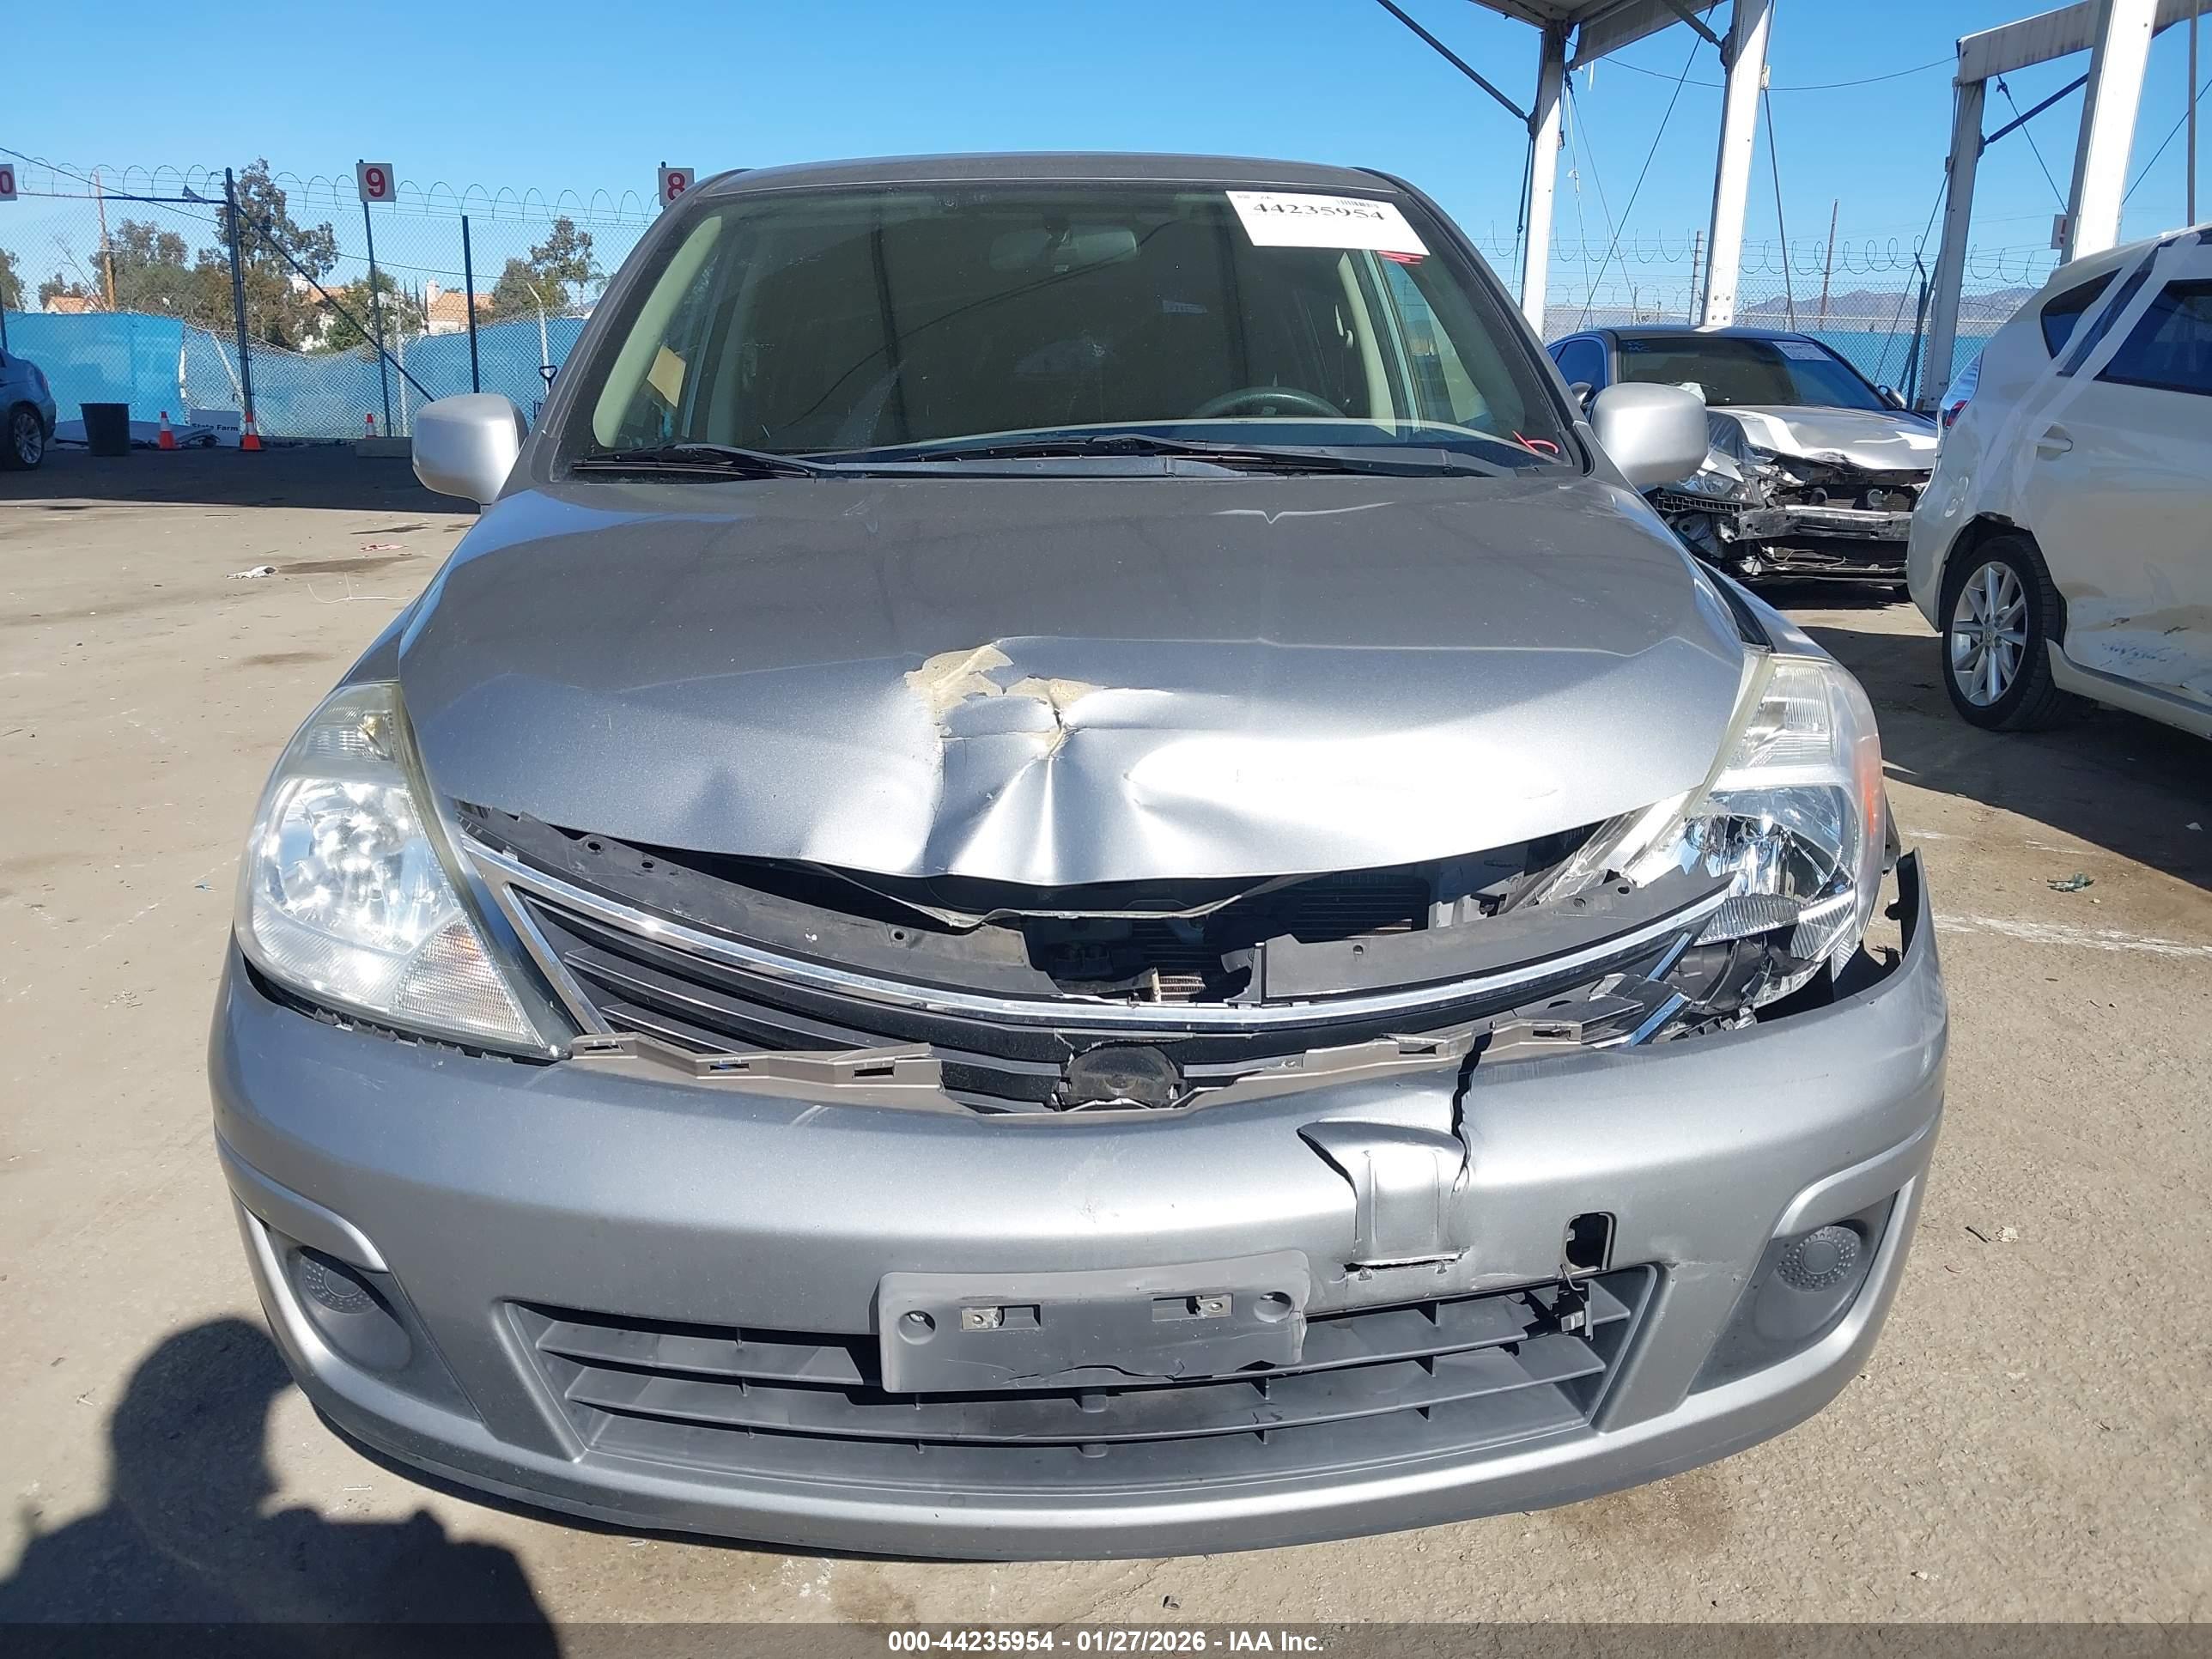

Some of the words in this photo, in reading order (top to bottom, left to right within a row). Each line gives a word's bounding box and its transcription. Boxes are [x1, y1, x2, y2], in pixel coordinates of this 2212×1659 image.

[366, 167, 386, 197] 9
[667, 173, 685, 200] 8
[1253, 203, 1385, 221] 44235954
